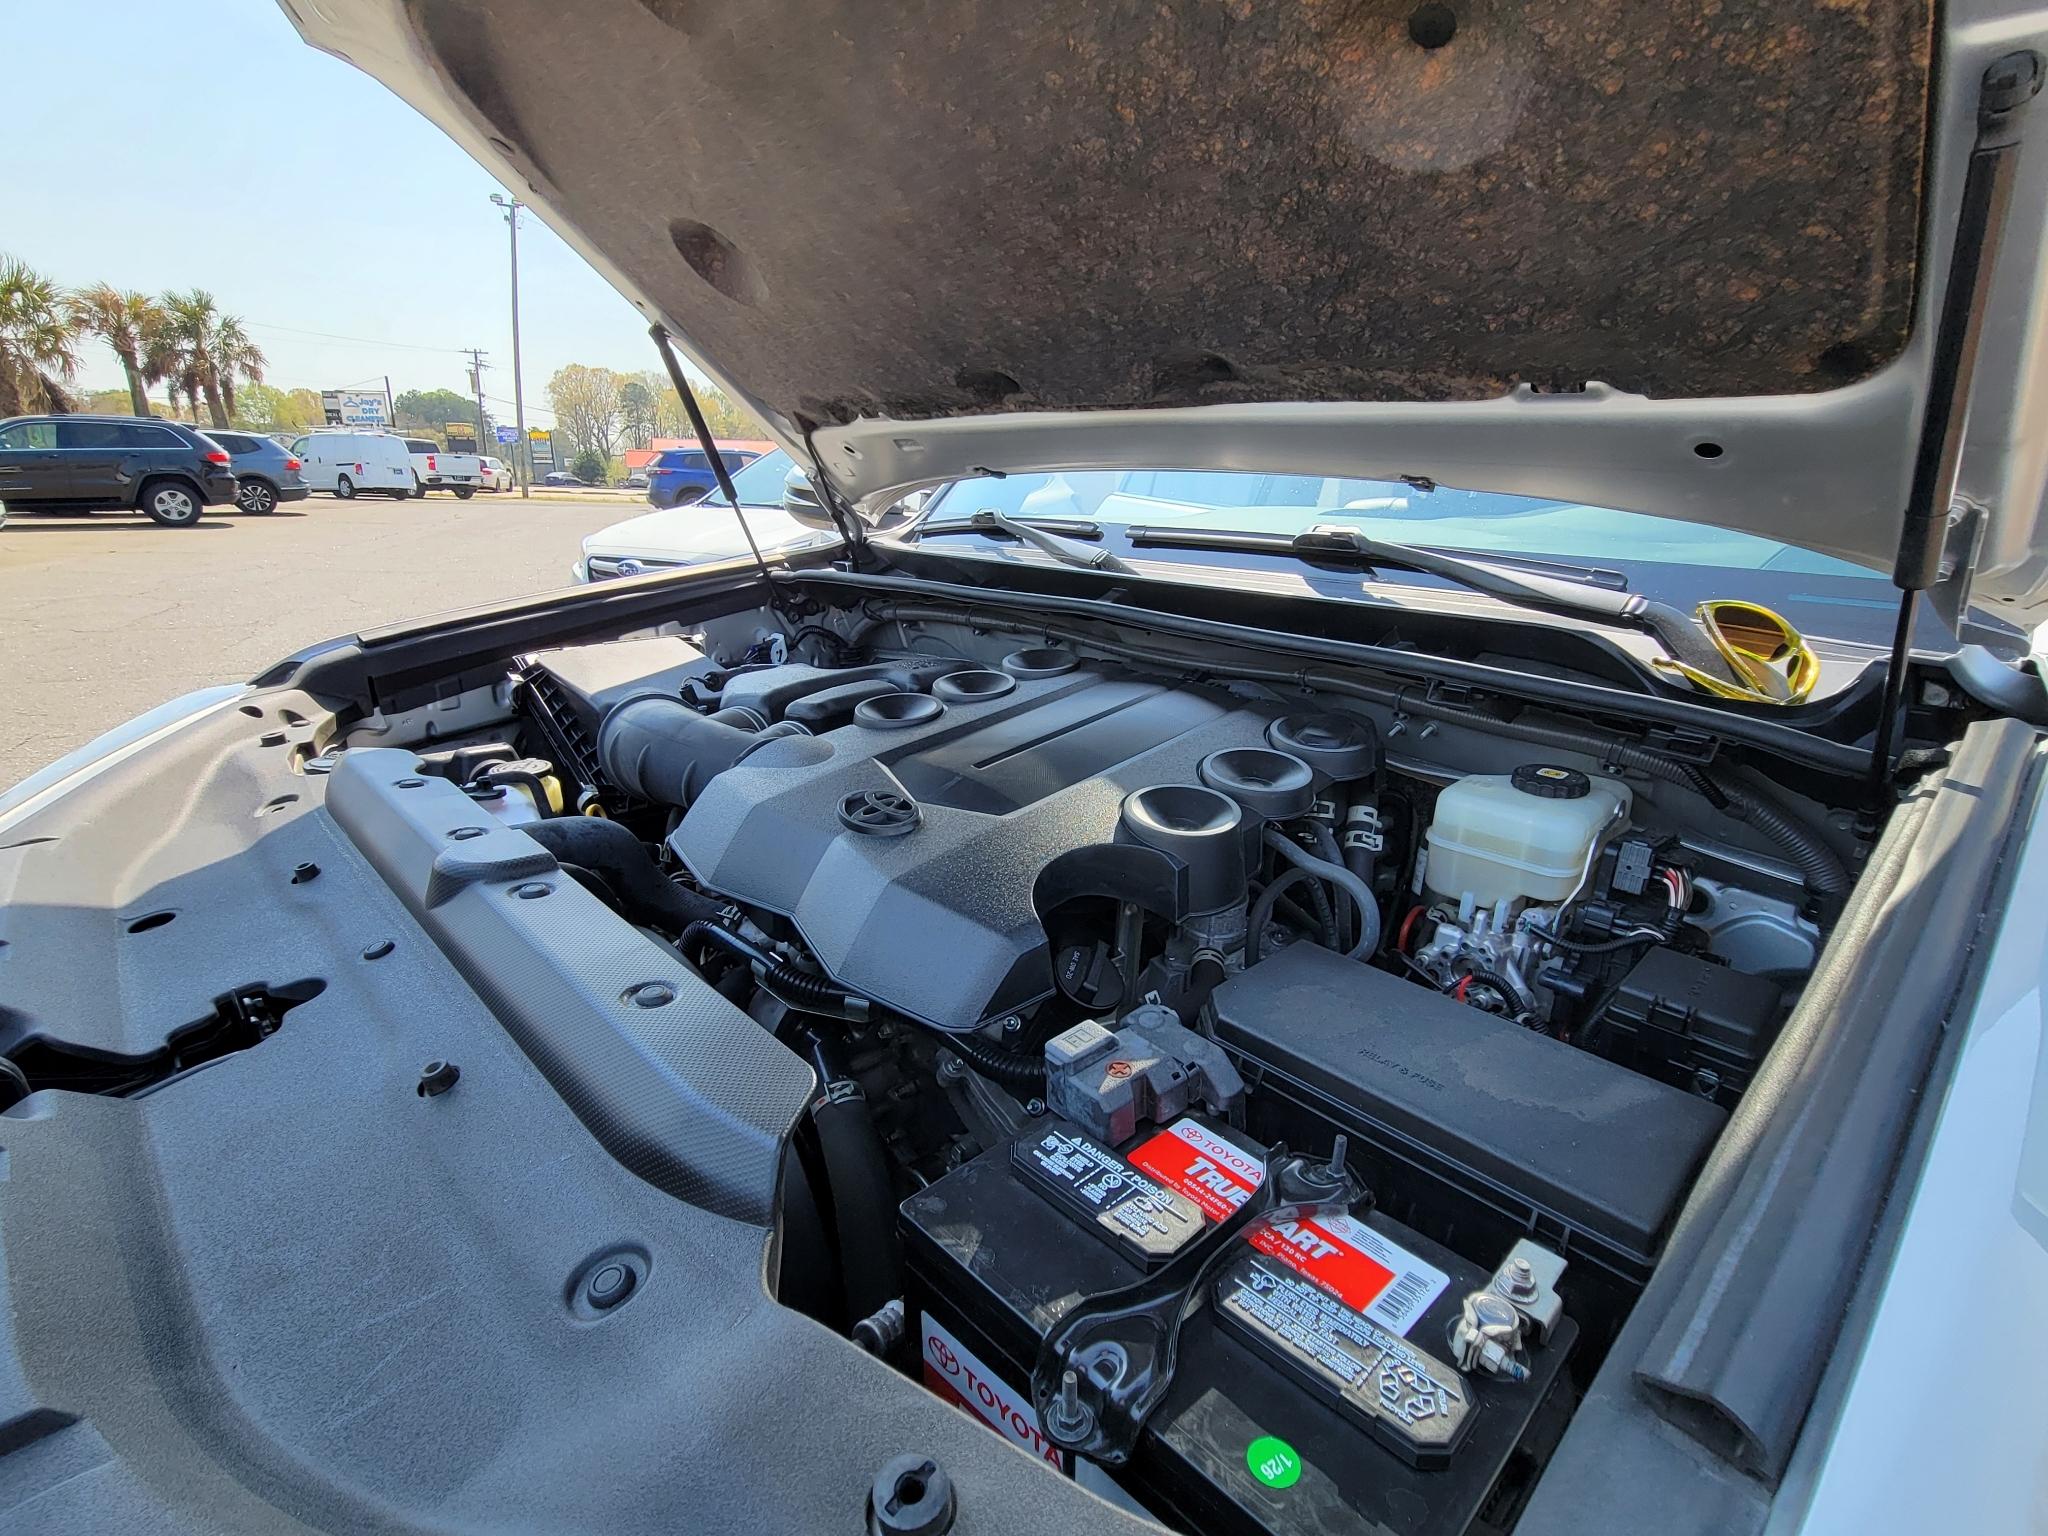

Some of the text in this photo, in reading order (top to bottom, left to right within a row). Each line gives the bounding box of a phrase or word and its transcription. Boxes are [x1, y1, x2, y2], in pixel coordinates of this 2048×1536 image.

[358, 397, 382, 406] Jay's
[1079, 1142, 1125, 1172] DANGER
[1130, 1174, 1174, 1204] POISON
[1204, 1140, 1262, 1181] TOYOTA
[1142, 1161, 1175, 1184] Distributed
[1181, 1187, 1201, 1204] Toyota
[1201, 1201, 1220, 1216] Motor
[1281, 1243, 1295, 1255] 130
[1294, 1252, 1307, 1263] RC
[1300, 1267, 1319, 1284] Texas
[1265, 1294, 1339, 1345] MEDICAL HELP FAST
[1271, 1289, 1293, 1305] WITH
[1317, 1320, 1335, 1334] GET
[1275, 1284, 1370, 1348] FLUSH EYES IMMEDIATELY
[963, 1366, 1062, 1472] TOYOTA
[1260, 1453, 1293, 1480] 1/26
